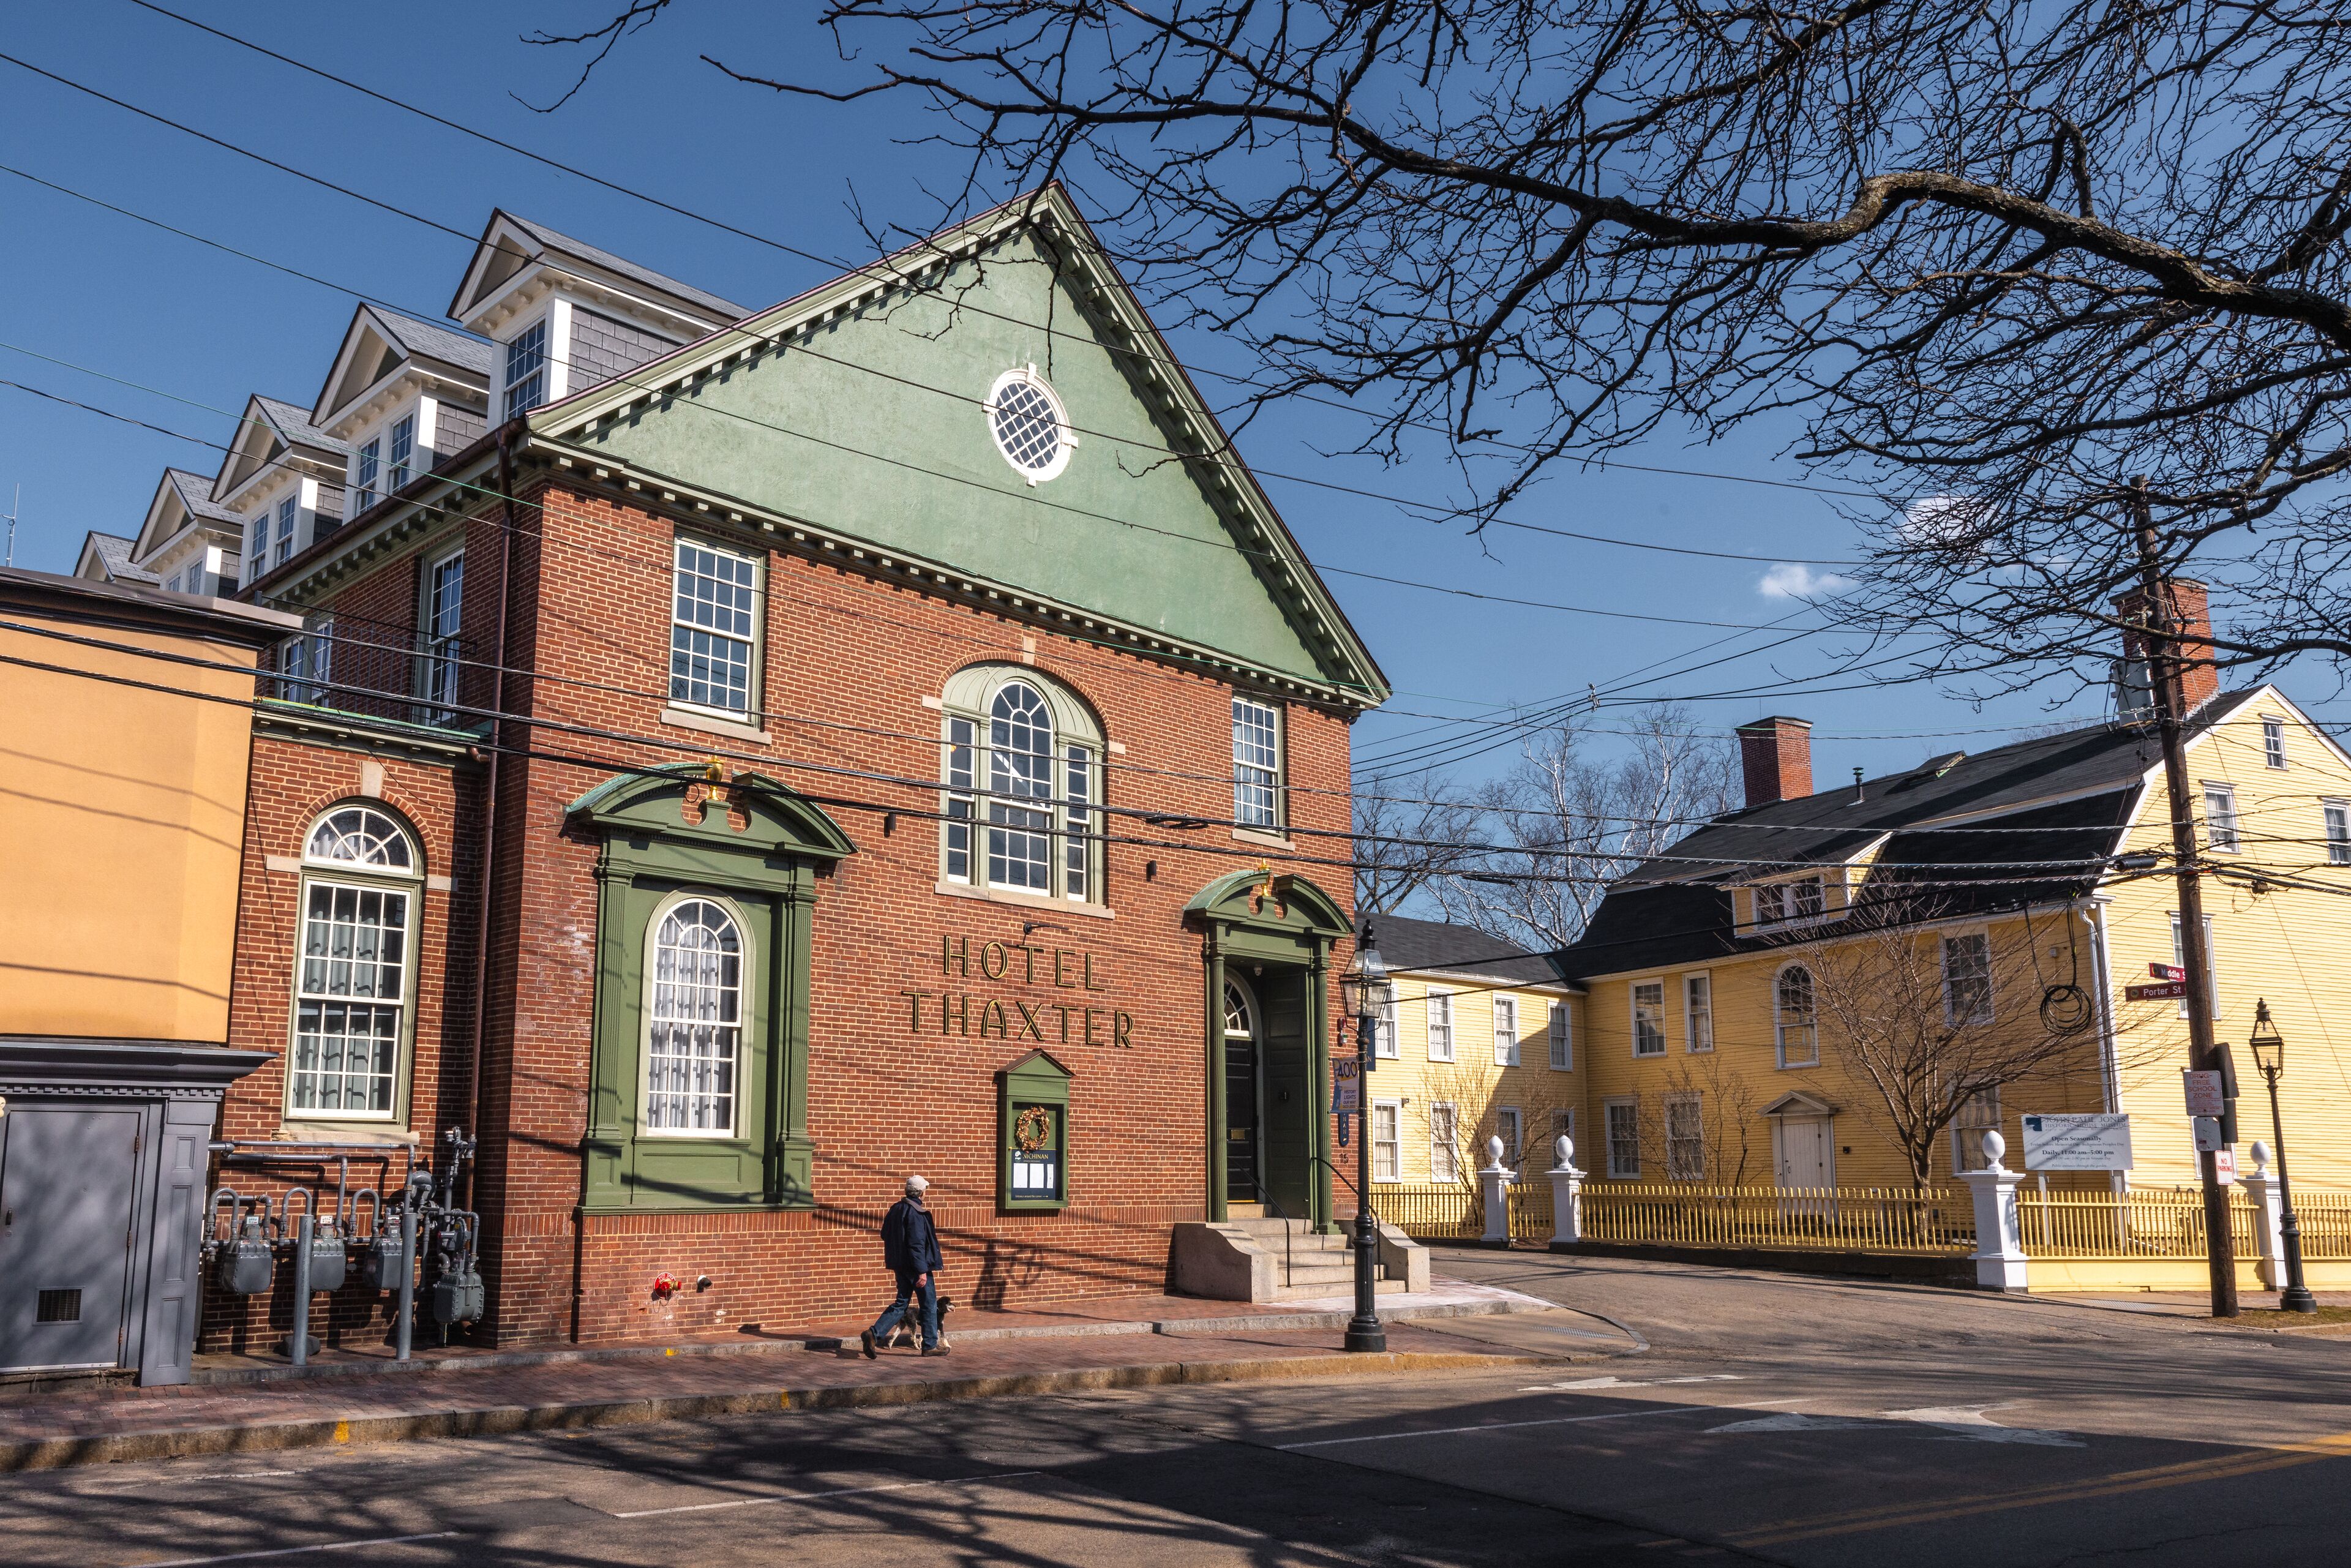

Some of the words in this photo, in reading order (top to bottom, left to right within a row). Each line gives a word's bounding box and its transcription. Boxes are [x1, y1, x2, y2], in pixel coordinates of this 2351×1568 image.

[943, 935, 1105, 991] HOTEL
[2161, 969, 2180, 978] Middle
[2143, 988, 2168, 997] Porter
[901, 990, 1134, 1048] THAXTER
[1340, 1153, 1349, 1164] 15
